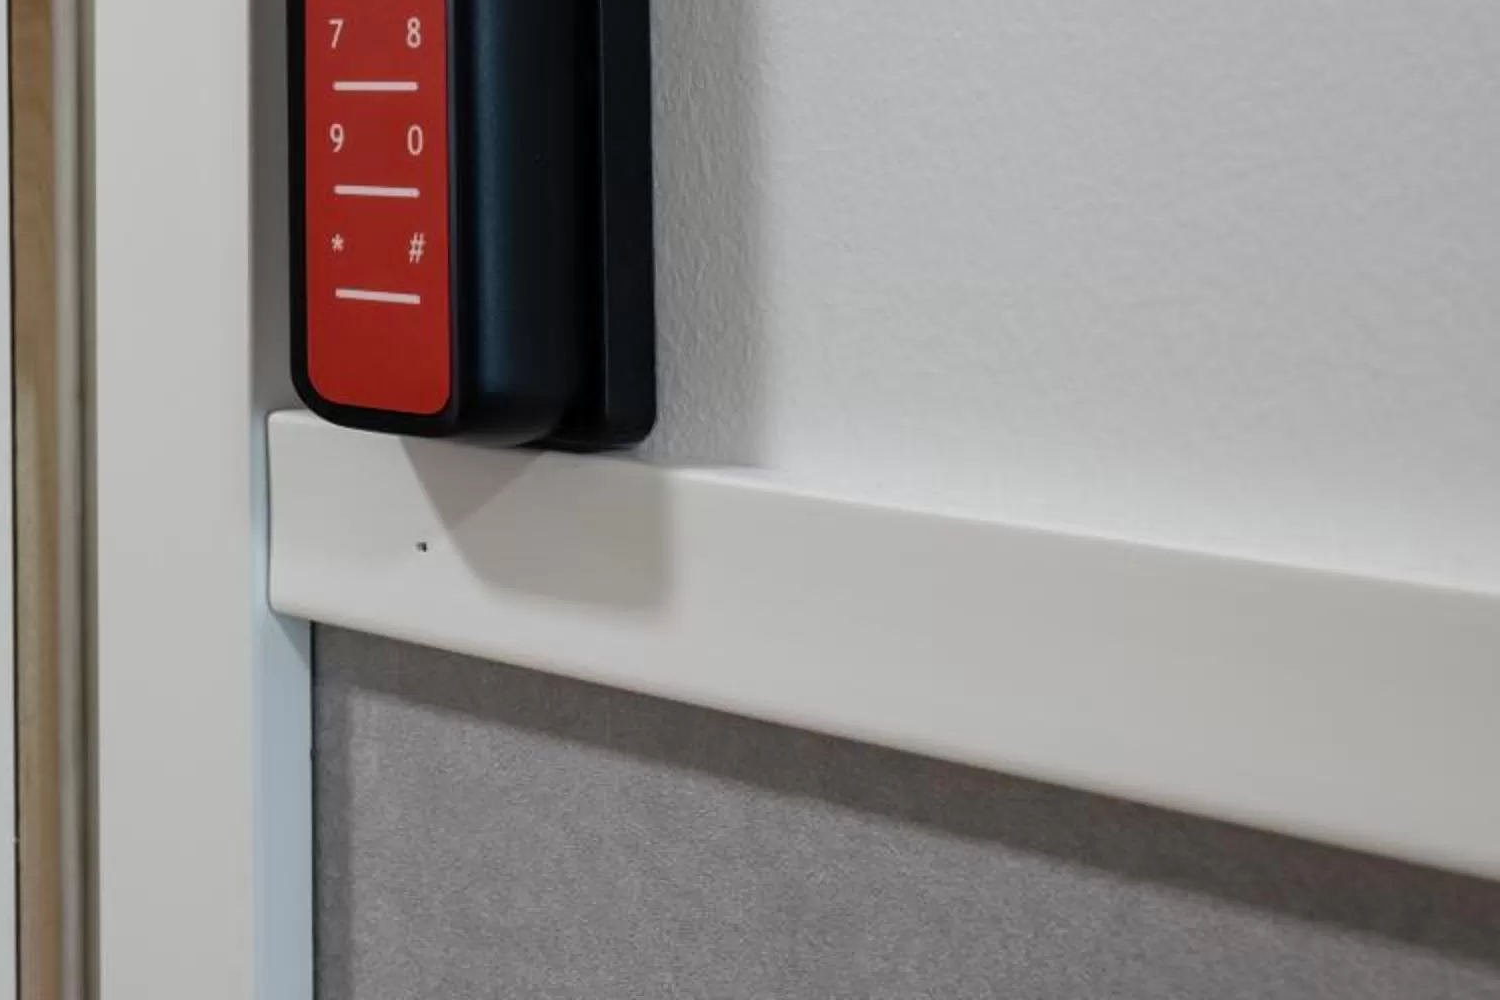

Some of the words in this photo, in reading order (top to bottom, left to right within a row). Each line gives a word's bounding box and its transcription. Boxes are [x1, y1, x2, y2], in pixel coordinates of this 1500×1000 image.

[328, 18, 344, 49] 7
[406, 17, 422, 49] 8
[329, 123, 345, 153] 9
[407, 124, 423, 156] 0
[408, 232, 425, 264] #
